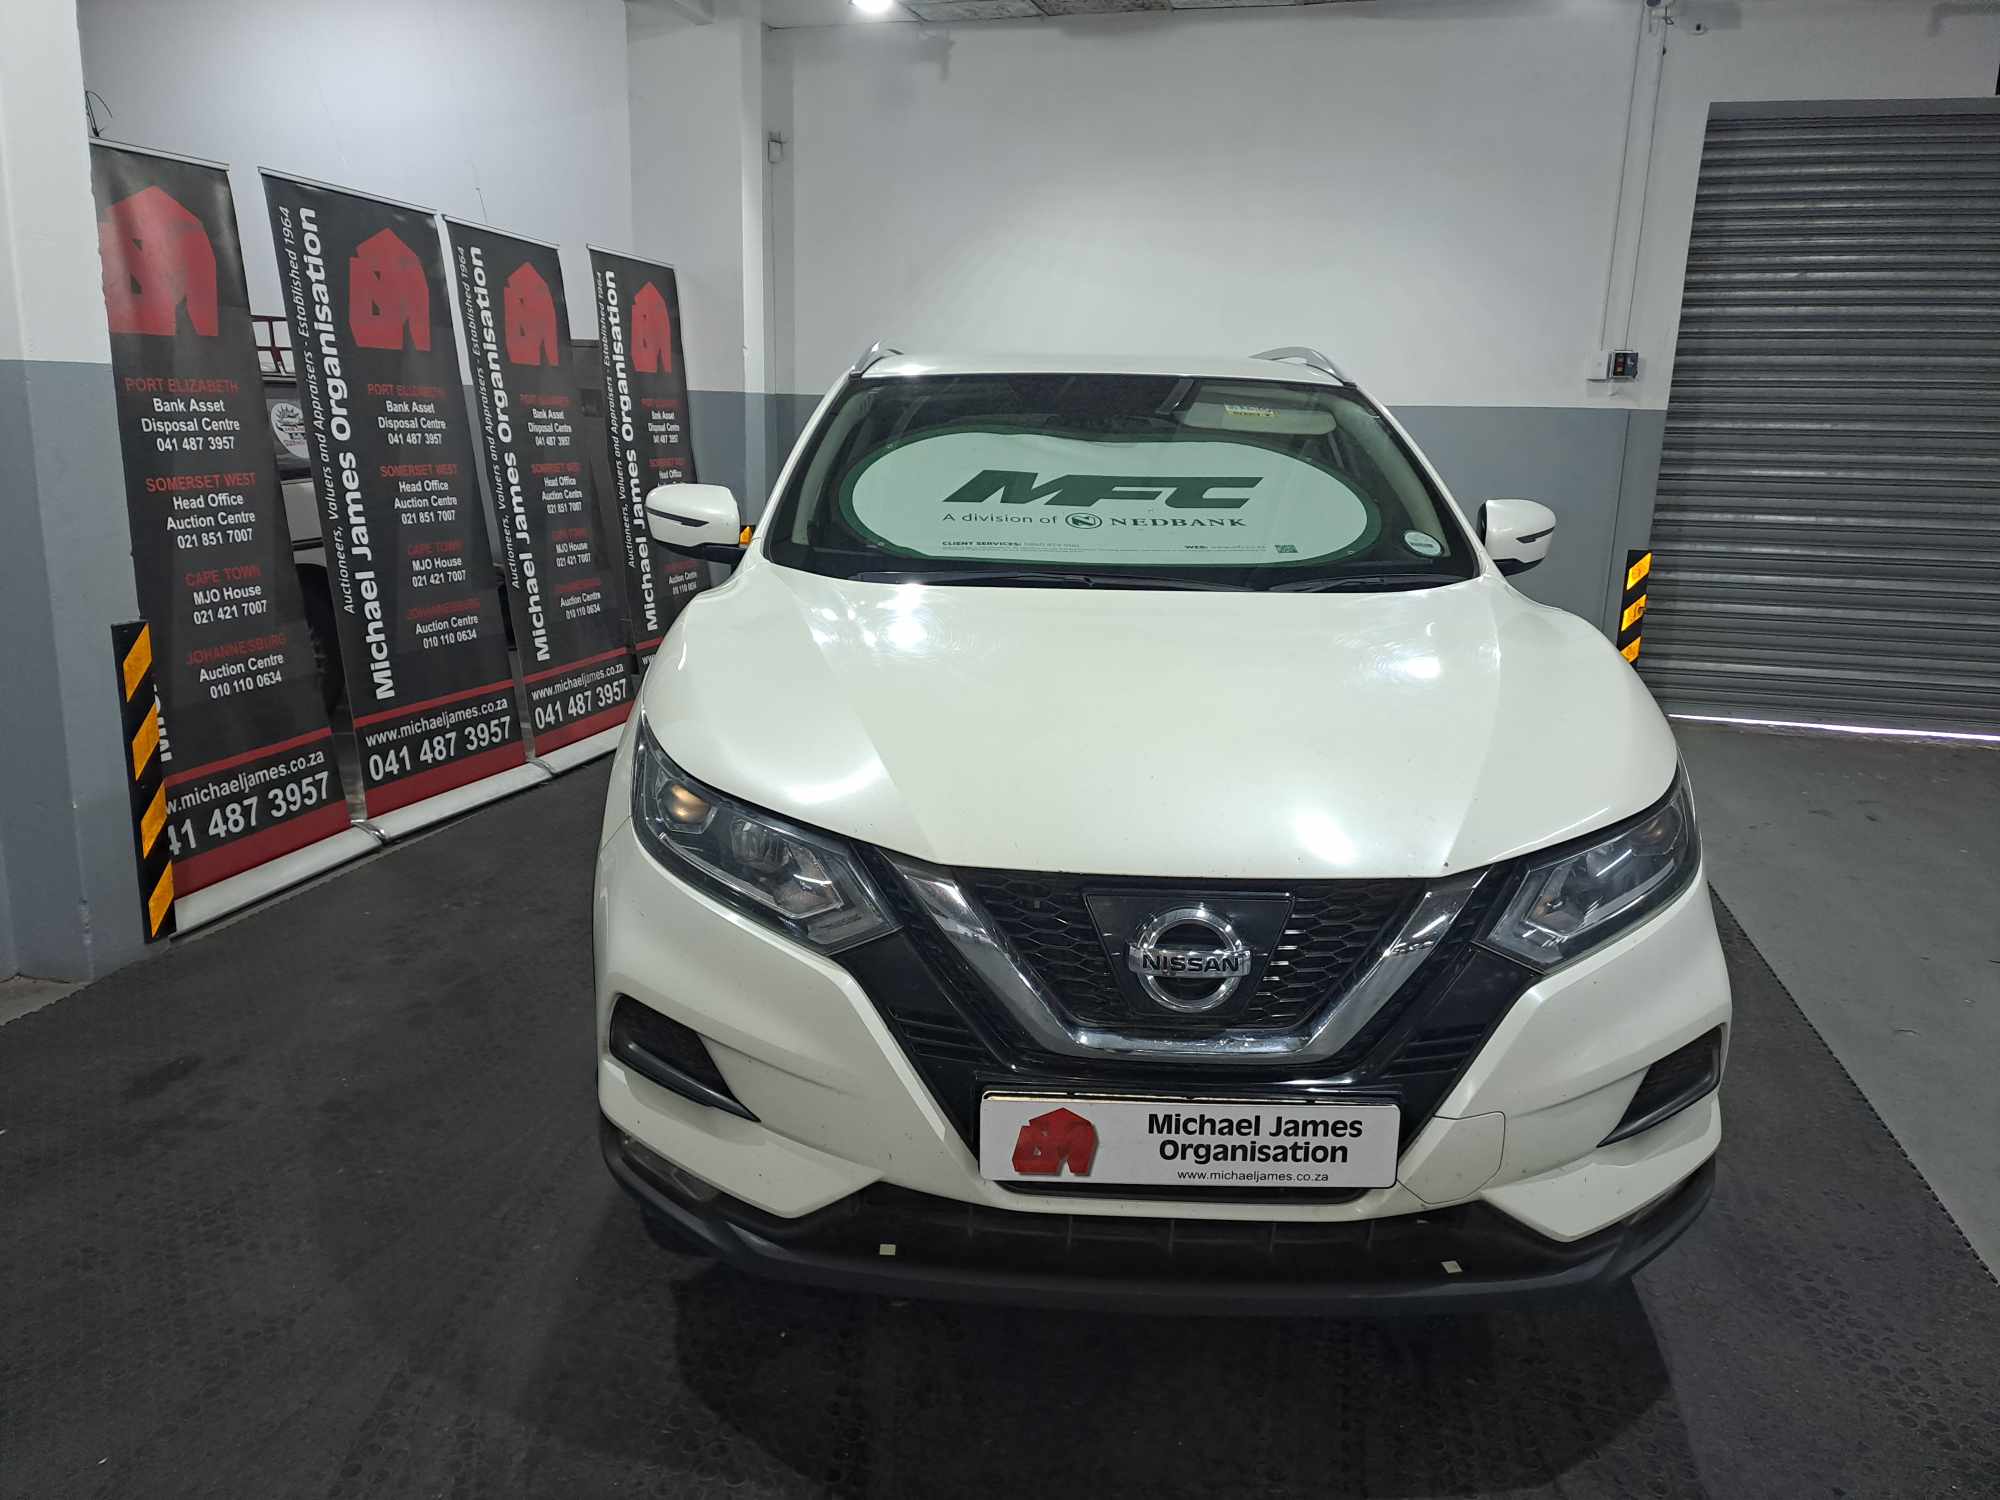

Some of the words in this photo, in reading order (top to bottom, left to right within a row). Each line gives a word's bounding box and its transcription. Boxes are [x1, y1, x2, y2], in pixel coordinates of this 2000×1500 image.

[280, 206, 297, 245] 1964
[284, 248, 309, 337] Established
[299, 207, 352, 441] Organisation
[464, 284, 480, 355] Established
[470, 247, 512, 443] Organisation
[605, 271, 634, 442] Organisation
[303, 348, 325, 430] Appraisers
[477, 367, 492, 433] Appraisers
[153, 398, 185, 413] Bank
[189, 399, 225, 412] Asset
[385, 400, 410, 413] Bank
[412, 401, 435, 413] Asset
[141, 417, 198, 434] Disposal
[202, 418, 240, 432] Centre
[378, 417, 418, 430] Disposal
[420, 417, 446, 429] Centre
[156, 437, 179, 452] 041
[182, 437, 204, 451] 487
[208, 435, 235, 451] 3957
[315, 432, 328, 462] and
[388, 433, 404, 445] 041
[406, 433, 422, 444] 487
[424, 433, 442, 445] 3957
[487, 433, 499, 461] and
[612, 430, 621, 458] and
[145, 474, 221, 493] SOMERSET
[224, 472, 257, 488] WEST
[322, 465, 340, 520] Valuers
[399, 481, 422, 493] Head
[424, 479, 449, 491] Office
[494, 462, 506, 510] Valuers
[616, 459, 626, 500] Valuers
[627, 449, 645, 529] James
[942, 469, 1264, 509] MFC
[173, 495, 204, 511] Head
[207, 493, 243, 507] Office
[339, 452, 373, 561] James
[394, 497, 429, 509] Auction
[431, 495, 457, 506] Centre
[505, 452, 530, 544] James
[166, 513, 214, 532] Auction
[217, 510, 256, 526] Centre
[401, 512, 417, 525] 021
[419, 511, 435, 523] 851
[437, 509, 456, 521] 7007
[943, 513, 957, 522] A
[962, 512, 1033, 524] division
[1040, 515, 1057, 525] of
[1111, 518, 1249, 527] NEDBANK
[177, 531, 199, 549] 021
[202, 530, 224, 547] 851
[226, 527, 253, 544] 7007
[622, 501, 636, 568] Auctioneers,
[412, 559, 432, 571] MJO
[434, 556, 462, 570] House
[502, 515, 520, 589] Auctioneers,
[332, 525, 356, 614] Auctioneers,
[412, 575, 428, 588] 021
[430, 573, 446, 585] 421
[447, 569, 466, 583] 7007
[635, 537, 658, 631] Michael
[193, 588, 220, 606] MJO
[223, 585, 262, 601] House
[518, 553, 550, 661] Michael
[193, 609, 214, 625] 021
[217, 604, 239, 620] 421
[242, 599, 267, 616] 7007
[415, 618, 449, 634] Auction
[451, 613, 479, 627] Centre
[355, 570, 395, 700] Michael
[423, 637, 440, 649] 010
[441, 633, 455, 645] 110
[456, 628, 477, 643] 0634
[199, 660, 246, 682] Auction
[248, 652, 284, 671] Centre
[530, 663, 625, 700] www.michaeljames.co.za
[210, 684, 231, 699] 010
[234, 677, 254, 696] 110
[256, 670, 282, 690] 0634
[535, 700, 563, 729] 041
[568, 691, 592, 717] 487
[596, 678, 627, 708] 3957
[365, 698, 509, 748] www.michaeljames.co.za
[368, 749, 411, 781] 041
[419, 731, 457, 764] 487
[464, 716, 511, 751] 3957
[208, 795, 258, 838] 487
[267, 771, 329, 818] 3957
[1142, 953, 1239, 973] NISSAN
[1147, 1114, 1262, 1137] Michael
[1269, 1116, 1364, 1139] James
[1158, 1139, 1349, 1165] Organisation
[1177, 1168, 1330, 1184] www.michaeljames.co.za
